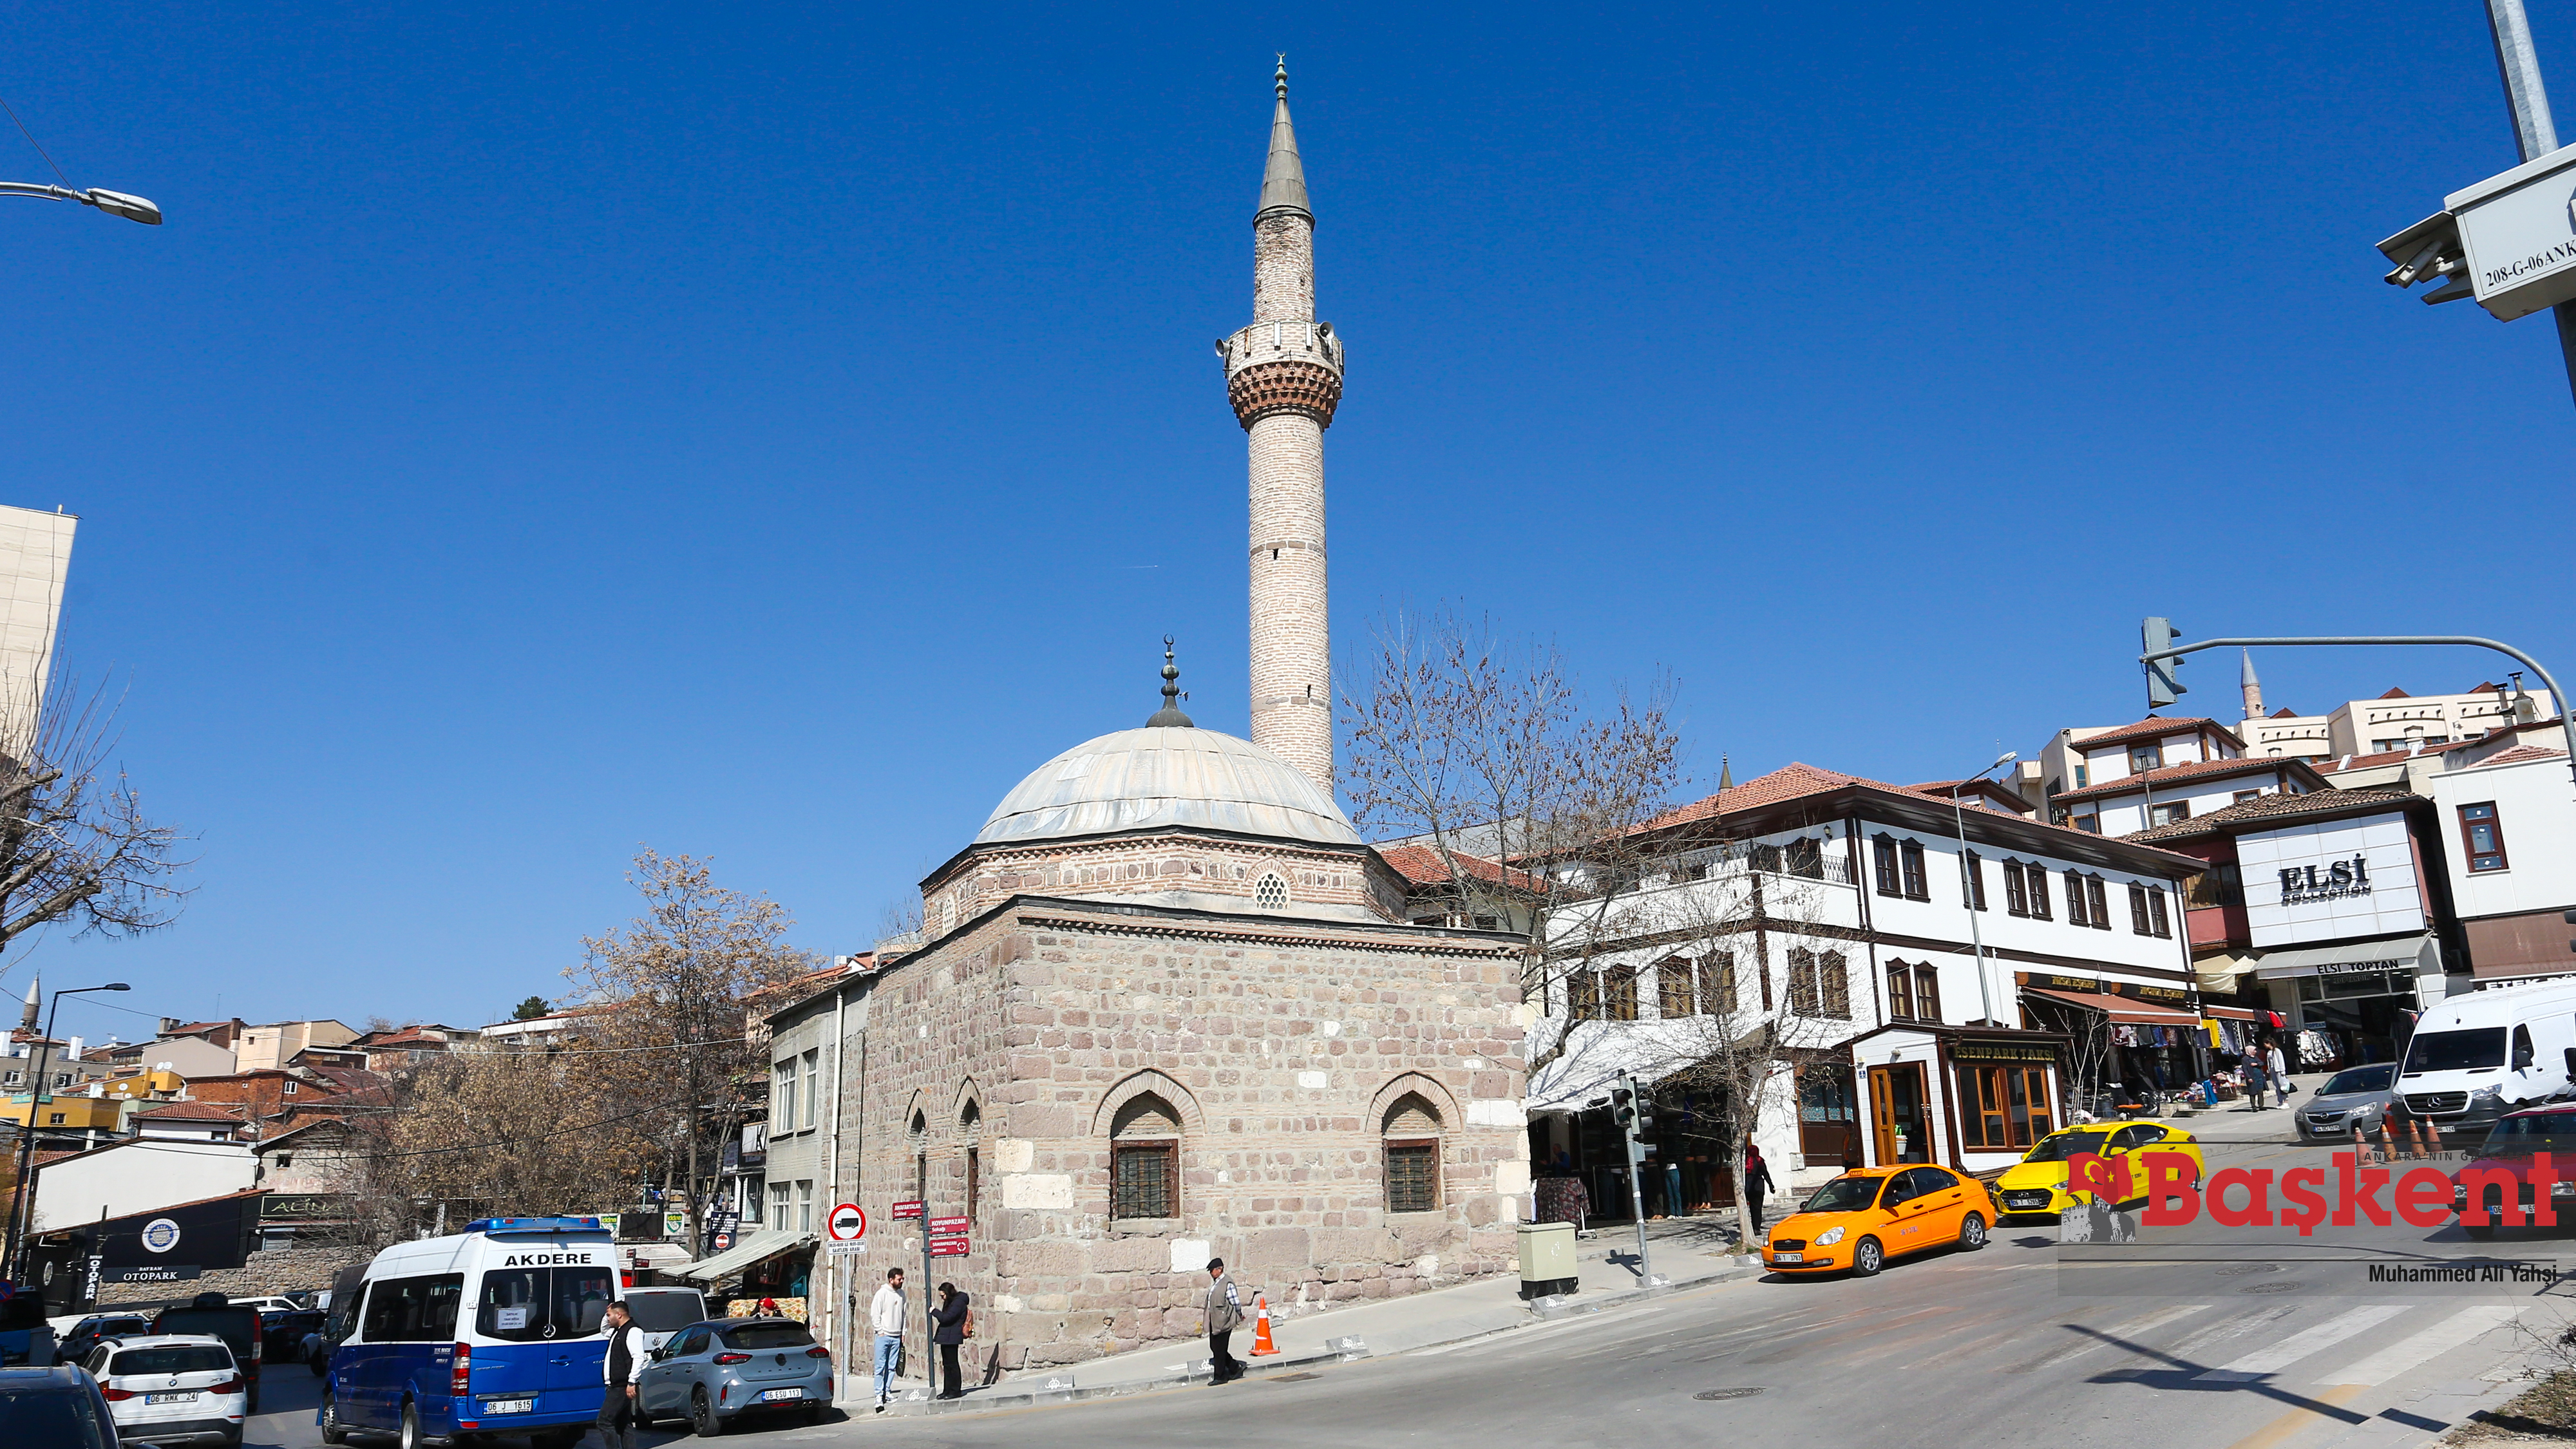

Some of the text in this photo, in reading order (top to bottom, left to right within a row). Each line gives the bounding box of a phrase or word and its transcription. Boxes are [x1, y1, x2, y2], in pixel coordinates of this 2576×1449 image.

[2278, 853, 2370, 892] ELSİ
[2282, 885, 2372, 902] COLLECTION
[2316, 960, 2399, 974] ELSI TOPTAN
[1955, 1046, 2018, 1059] ESENPARK
[931, 1218, 966, 1227] KOYUNPAZARI
[504, 1253, 592, 1267] AKDERE
[84, 1260, 100, 1300] OTOPARK
[123, 1271, 178, 1282] OTOPARK
[151, 1392, 195, 1403] 06 RMK 24
[488, 1400, 531, 1411] 06 J 1615
